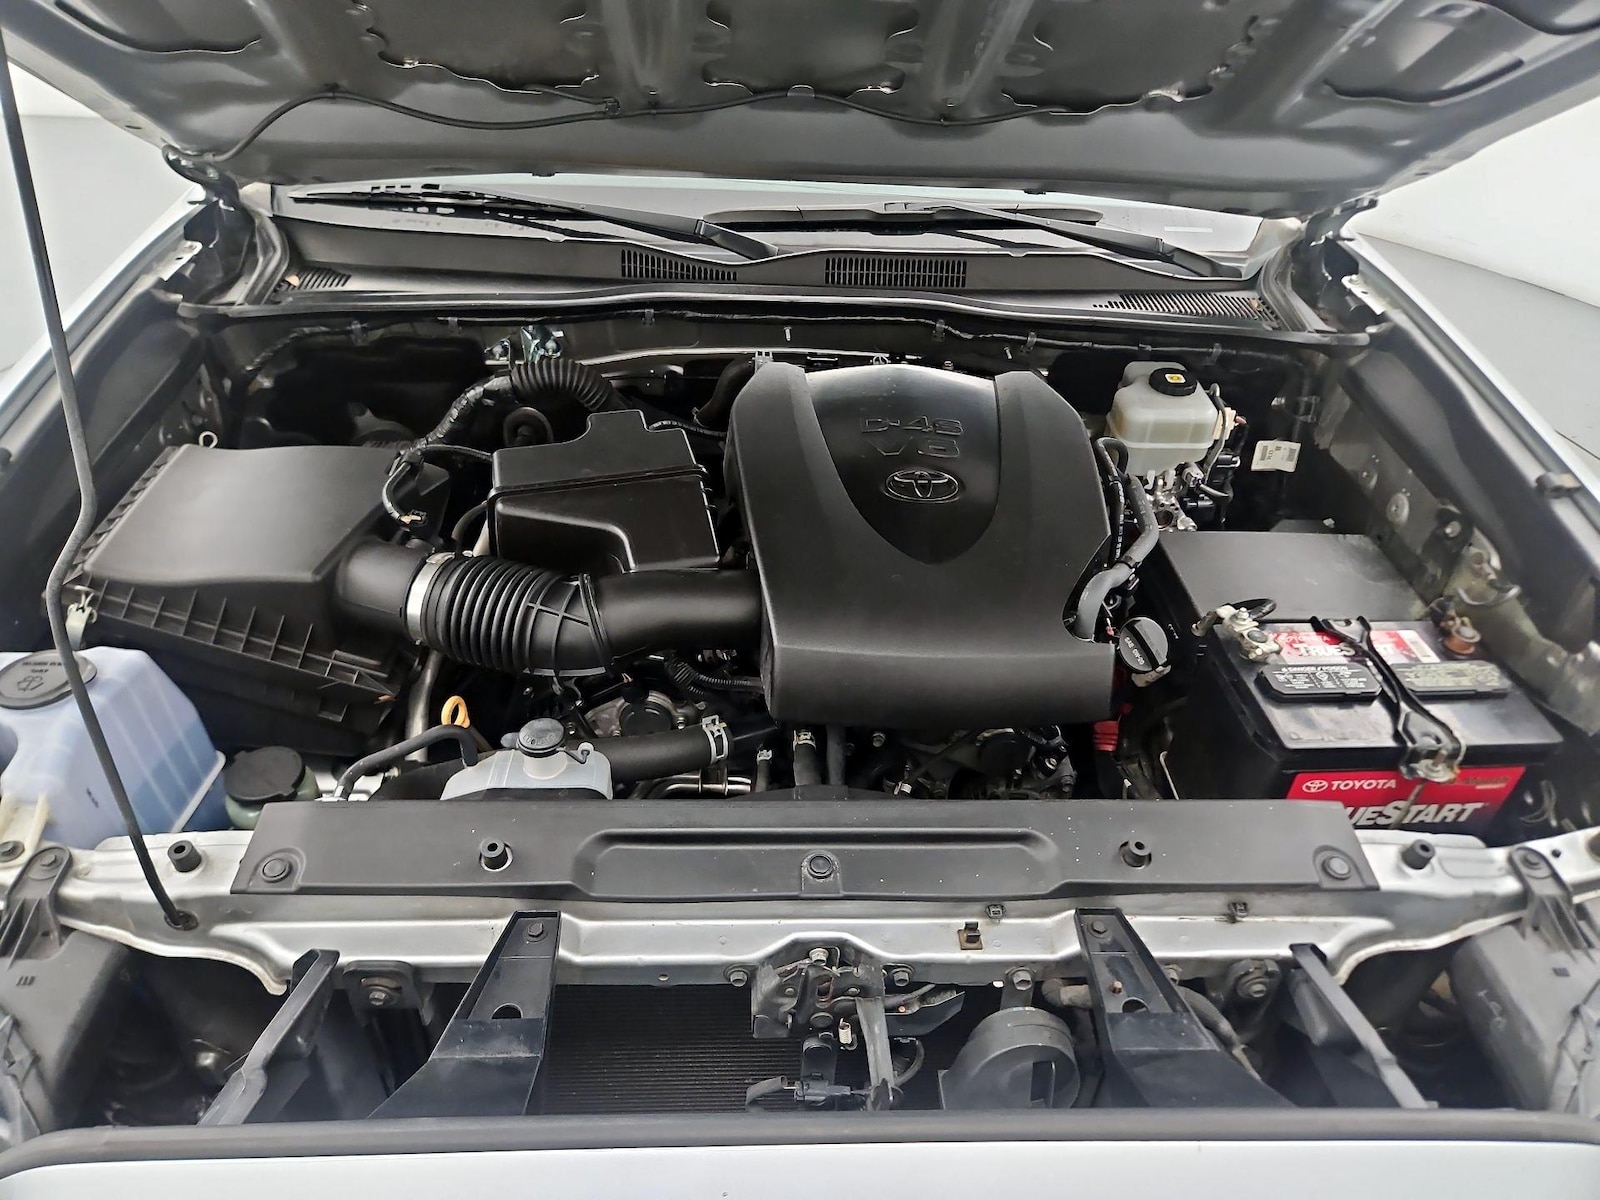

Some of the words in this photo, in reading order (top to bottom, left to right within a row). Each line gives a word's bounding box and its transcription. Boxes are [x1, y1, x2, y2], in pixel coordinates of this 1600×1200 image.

[860, 415, 963, 436] D-4S
[863, 436, 960, 458] V6
[1331, 778, 1397, 791] TOYOTA
[1346, 800, 1485, 826] UESTART
